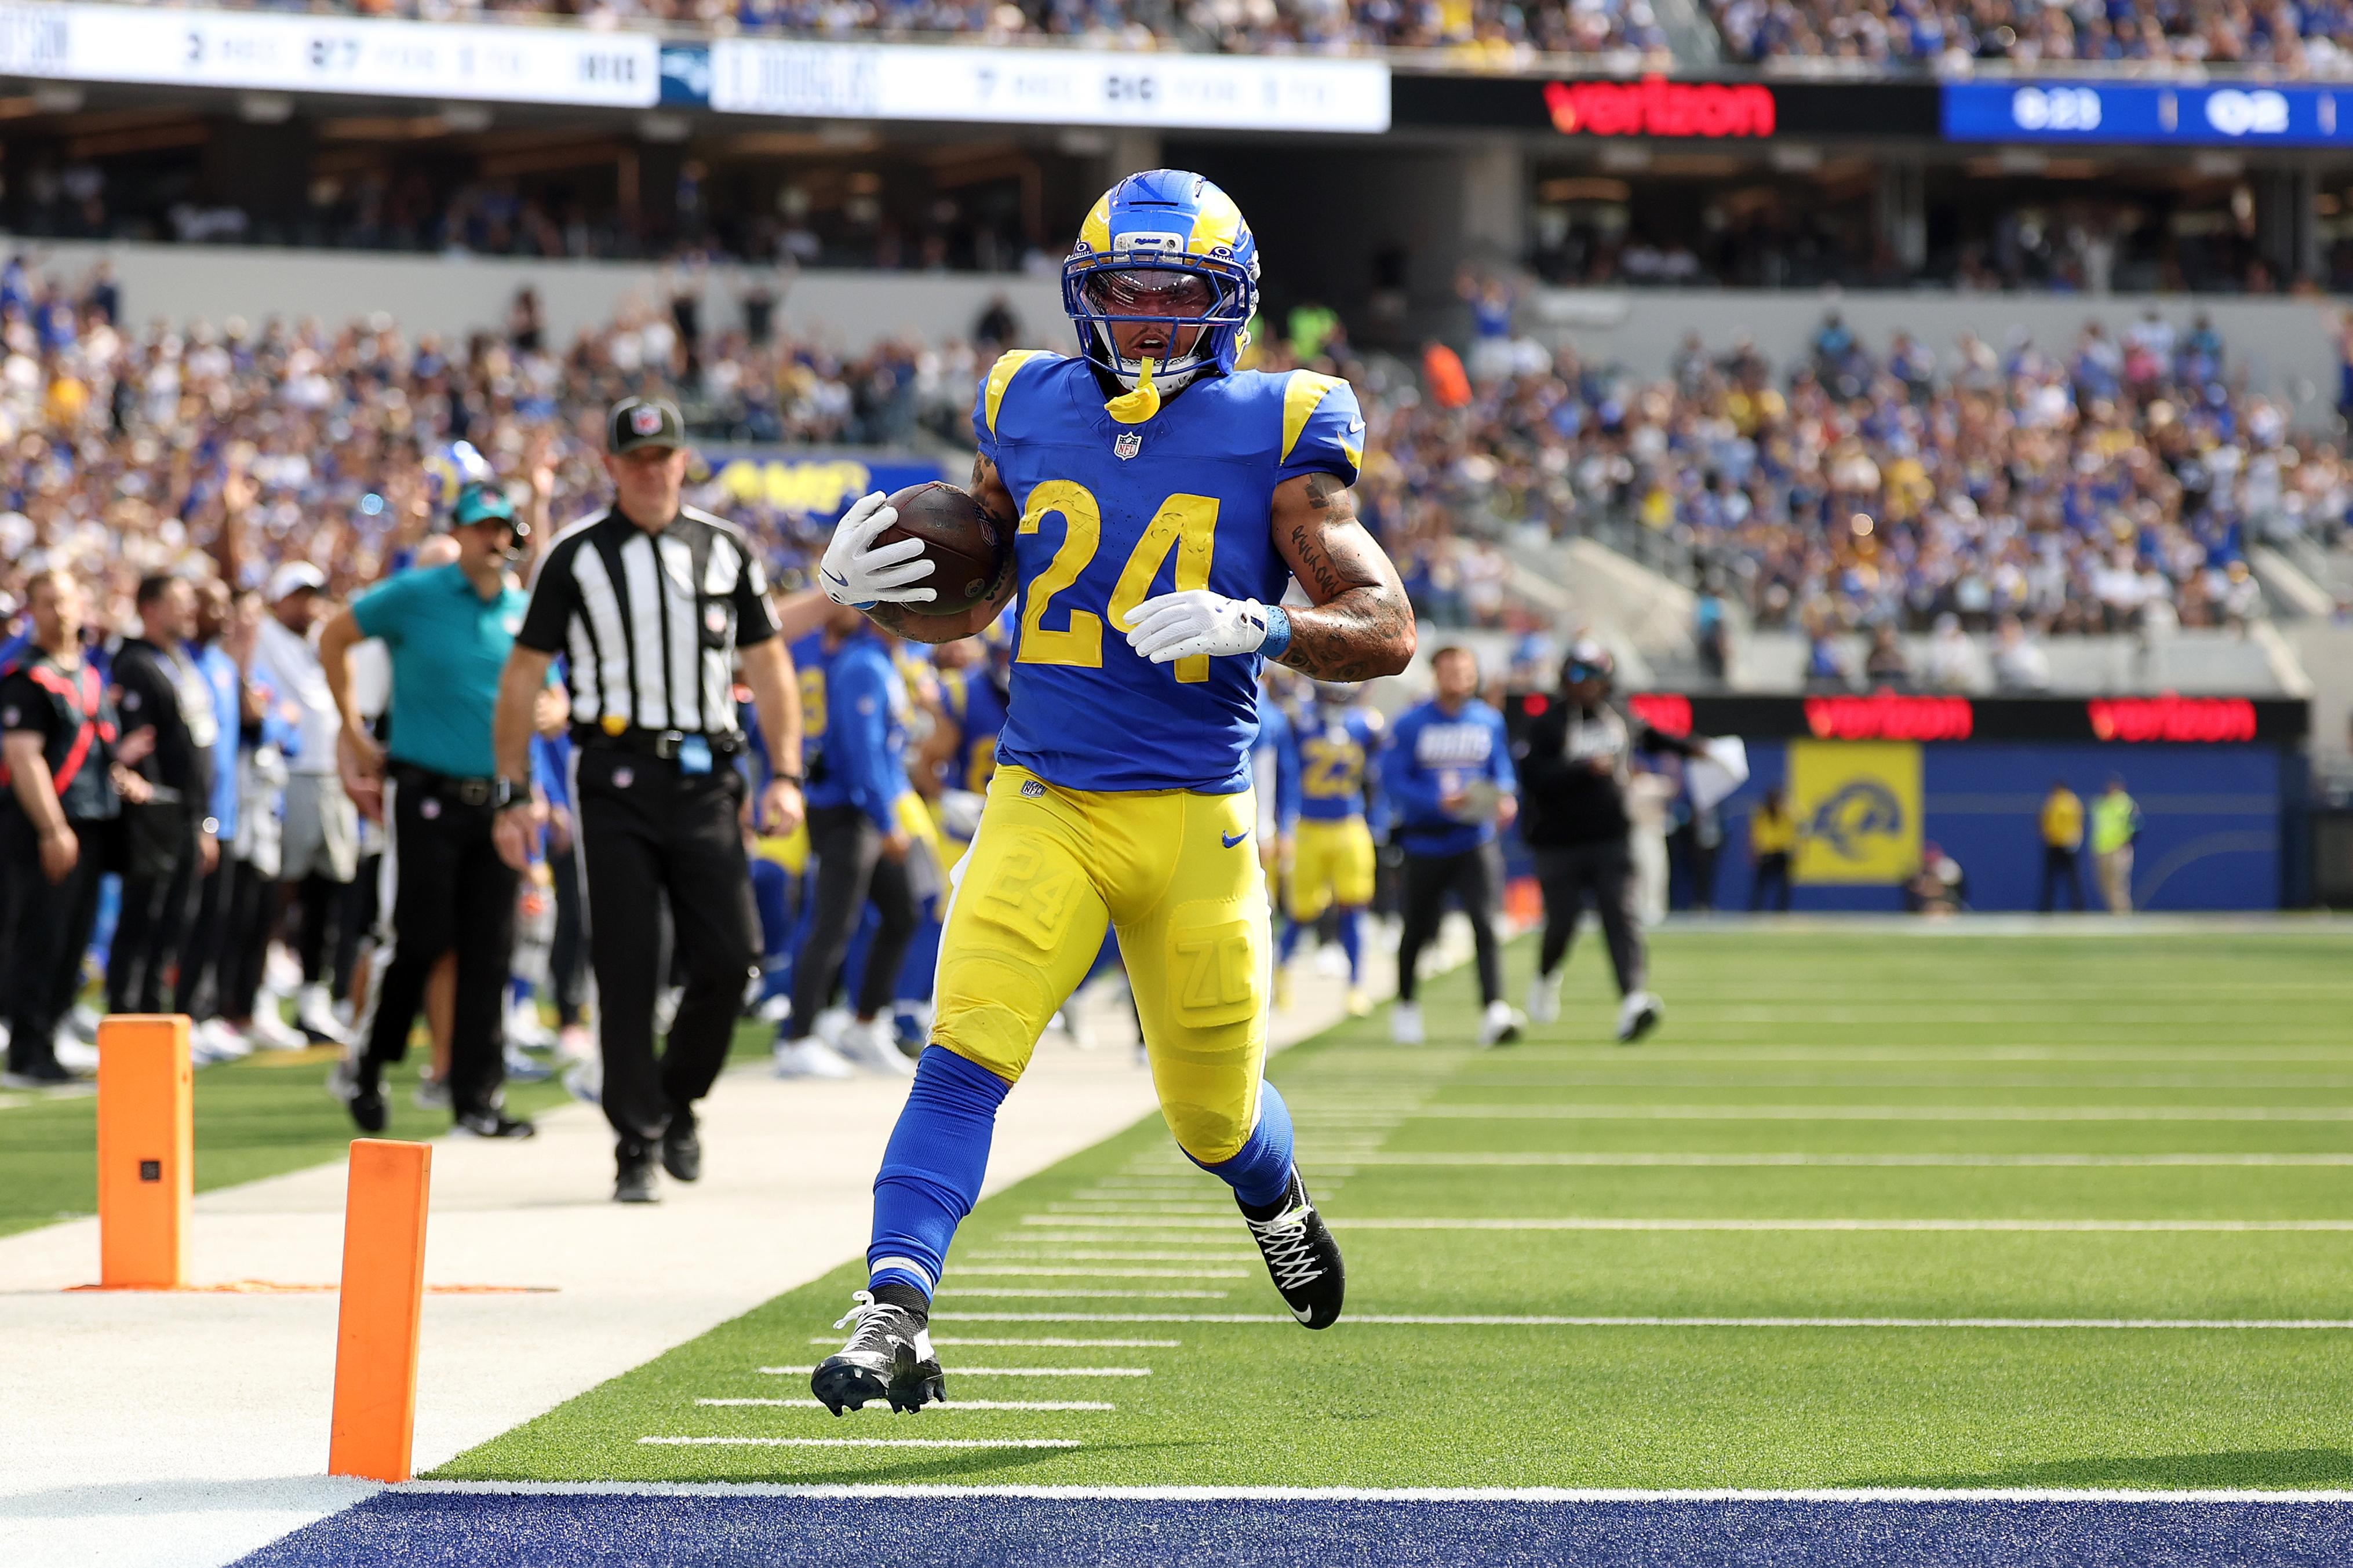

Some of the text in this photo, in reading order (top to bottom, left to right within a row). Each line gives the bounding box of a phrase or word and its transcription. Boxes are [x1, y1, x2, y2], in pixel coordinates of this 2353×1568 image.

[1119, 444, 1134, 455] NFL
[1015, 479, 1220, 683] 24
[1022, 785, 1044, 795] NFL
[984, 845, 1076, 931] 24
